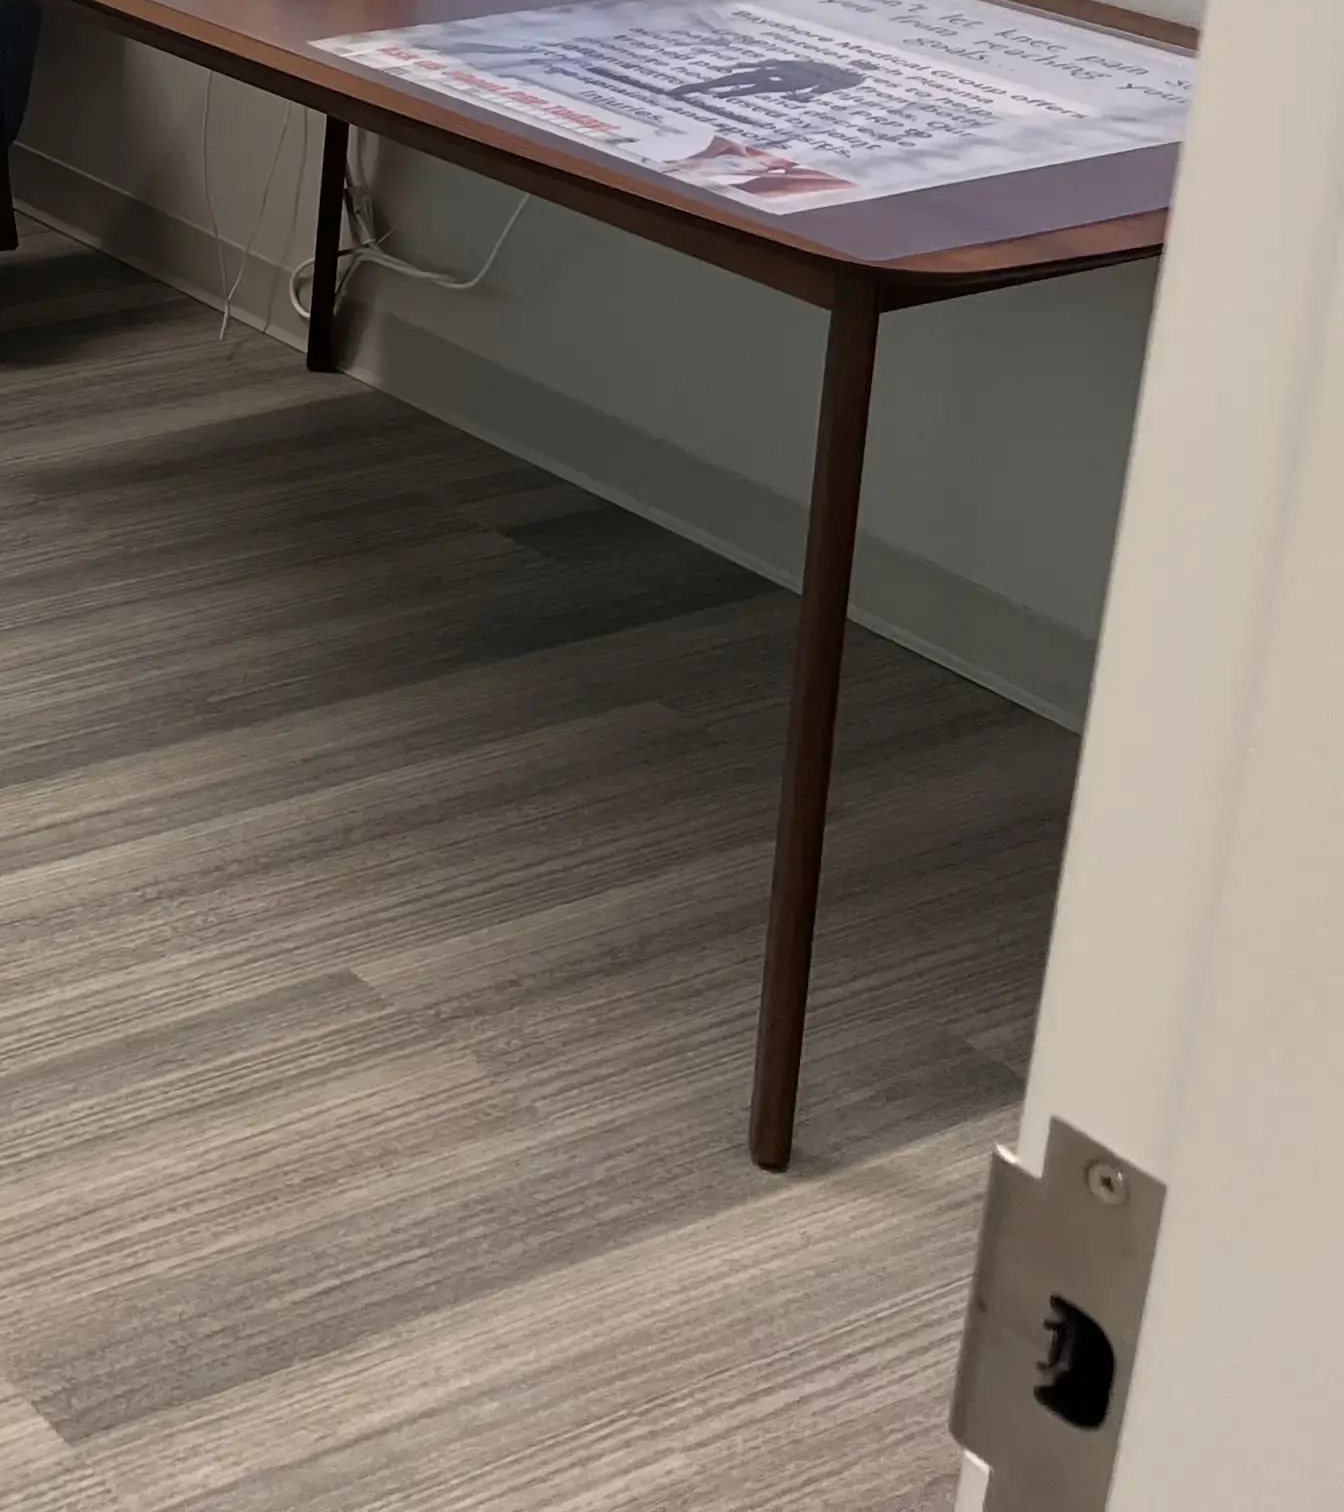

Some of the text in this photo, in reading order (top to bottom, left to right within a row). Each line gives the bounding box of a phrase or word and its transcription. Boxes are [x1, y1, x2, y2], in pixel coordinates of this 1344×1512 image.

[730, 10, 1089, 119] Bayshore Medical Group offers
[973, 39, 1113, 80] reaching
